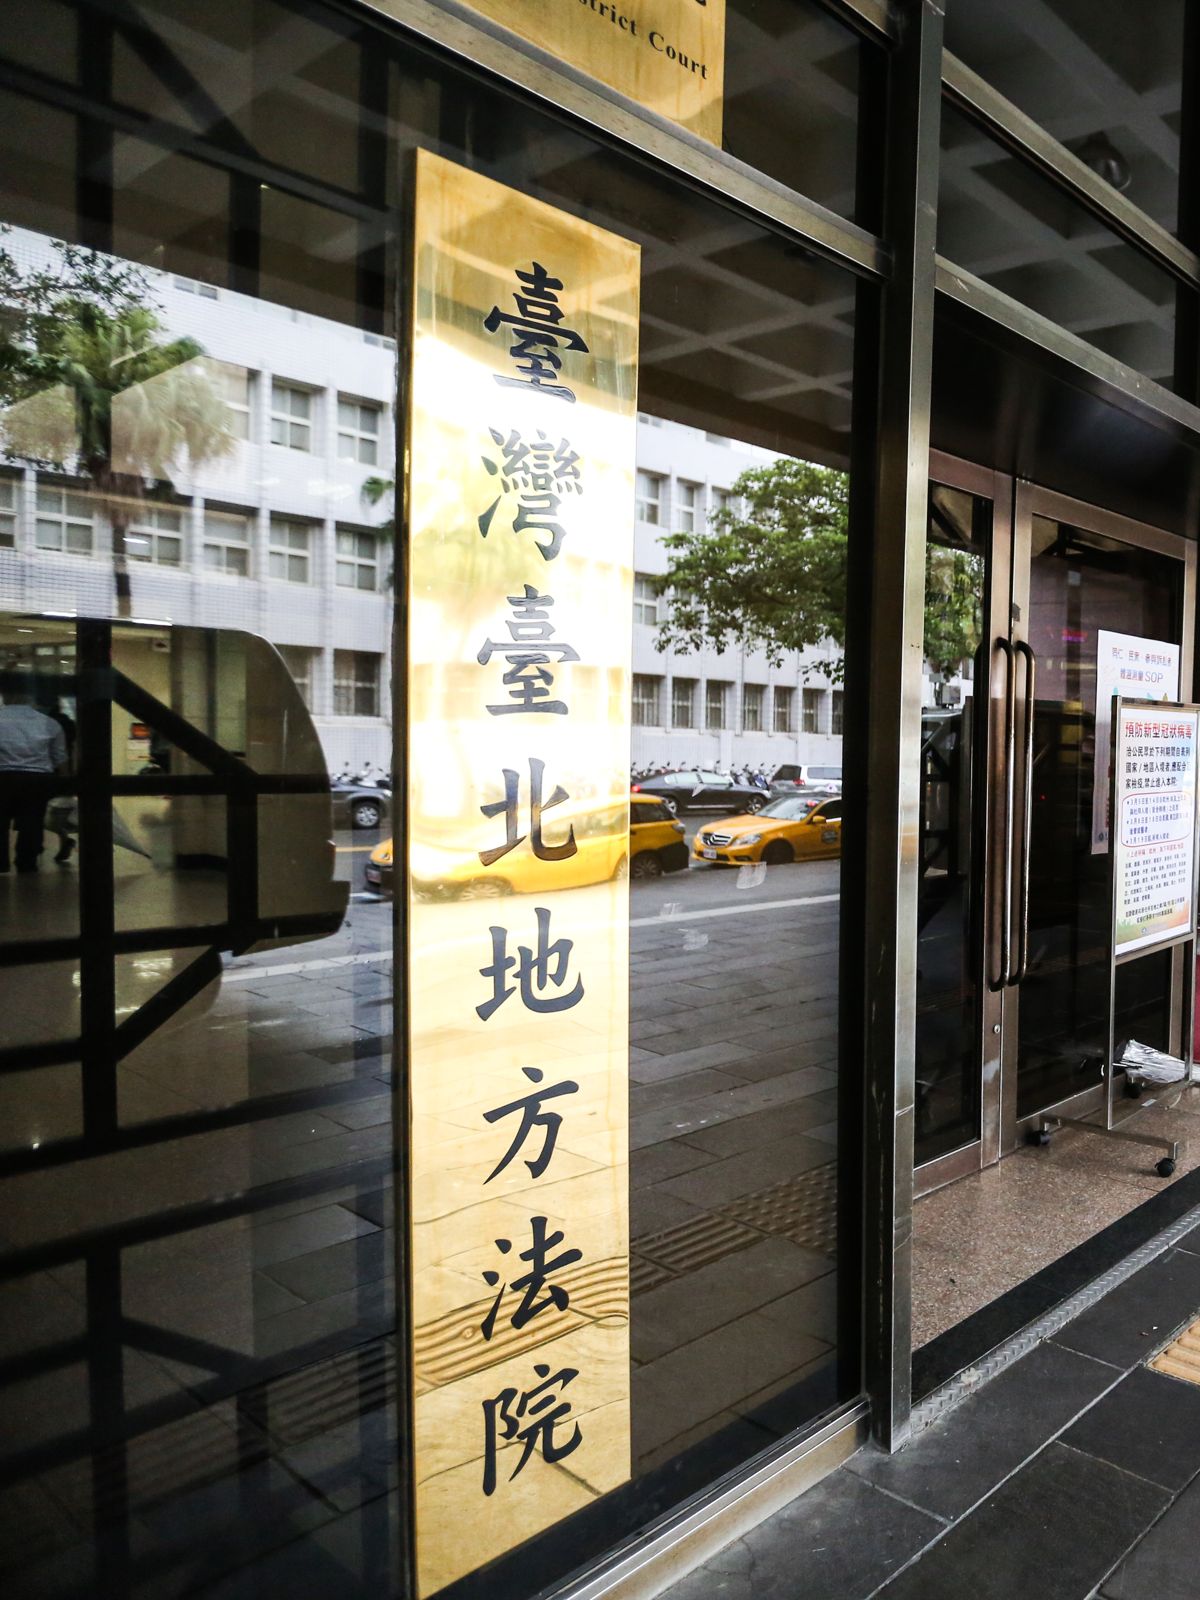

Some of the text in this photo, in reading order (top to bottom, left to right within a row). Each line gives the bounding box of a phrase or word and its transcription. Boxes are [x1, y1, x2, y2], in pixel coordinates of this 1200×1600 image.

[649, 31, 708, 80] Court
[477, 261, 590, 1496] 臺灣臺北地方法院
